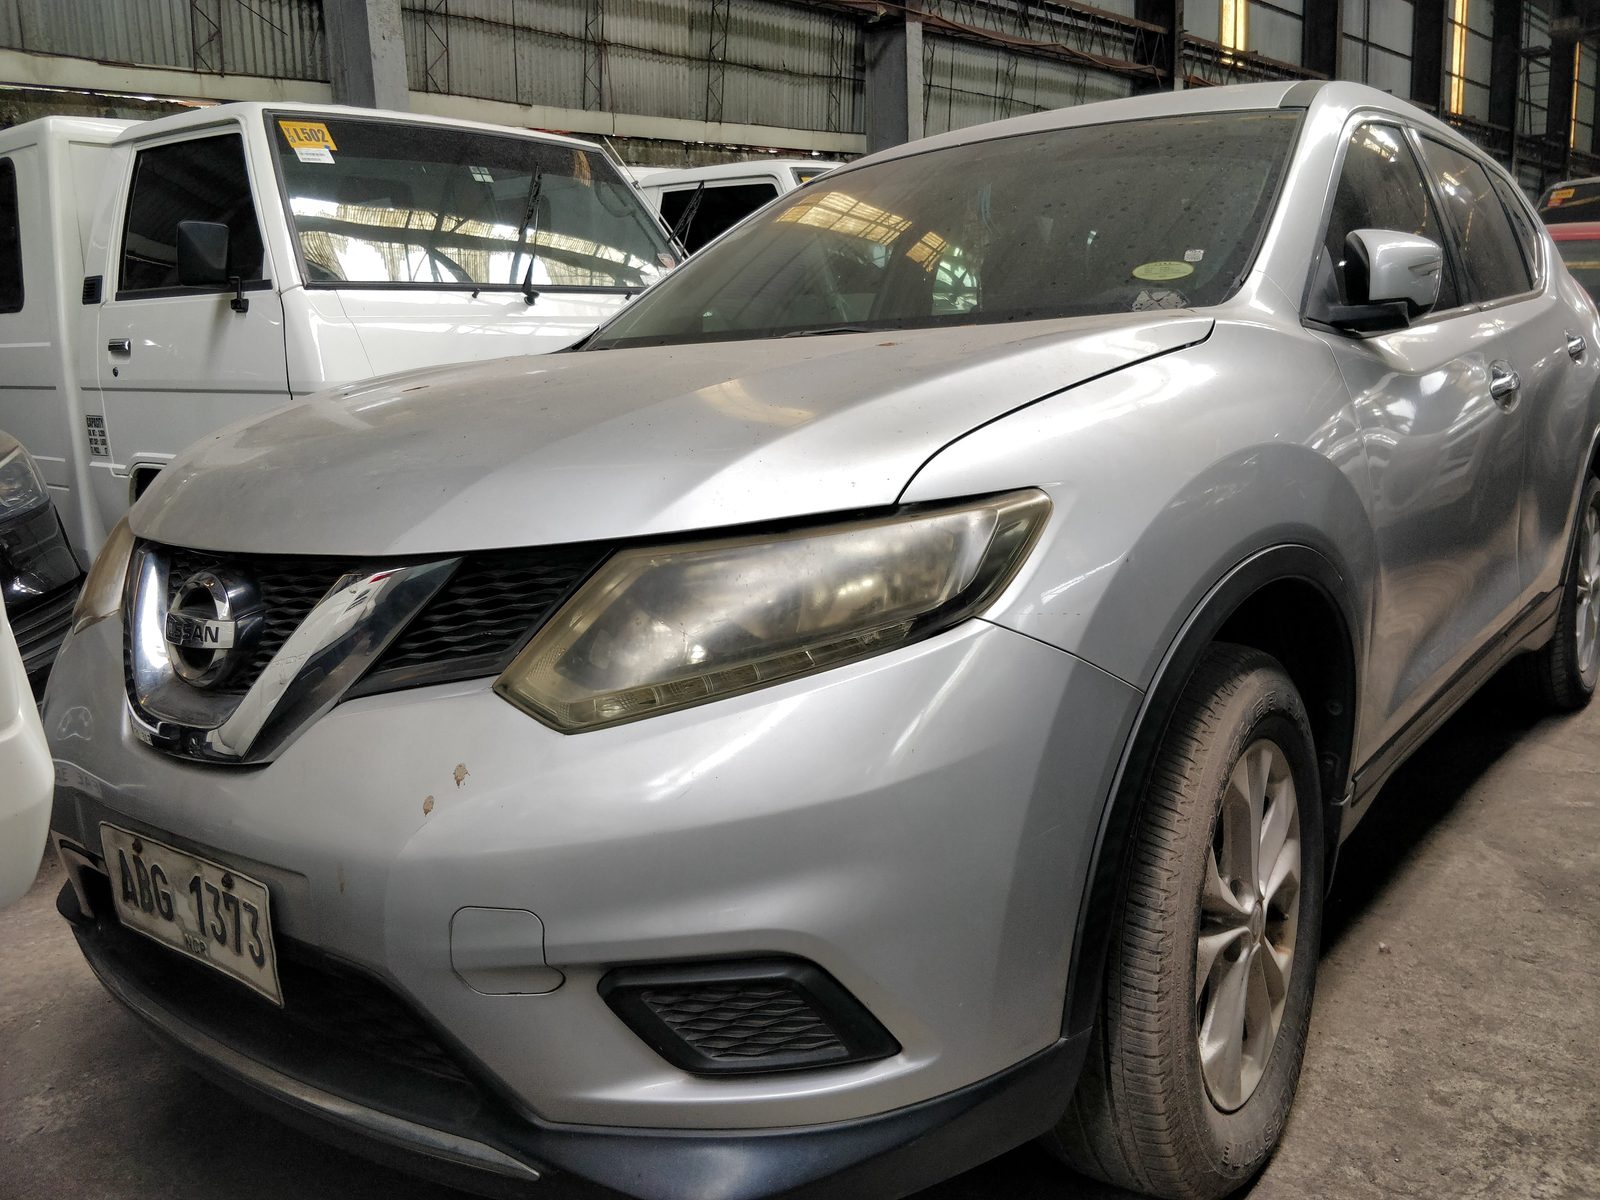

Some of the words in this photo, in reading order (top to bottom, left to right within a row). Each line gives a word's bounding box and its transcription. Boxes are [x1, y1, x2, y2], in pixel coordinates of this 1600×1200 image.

[168, 619, 219, 643] SSAN
[118, 848, 174, 922] ABG
[189, 875, 265, 968] 1373
